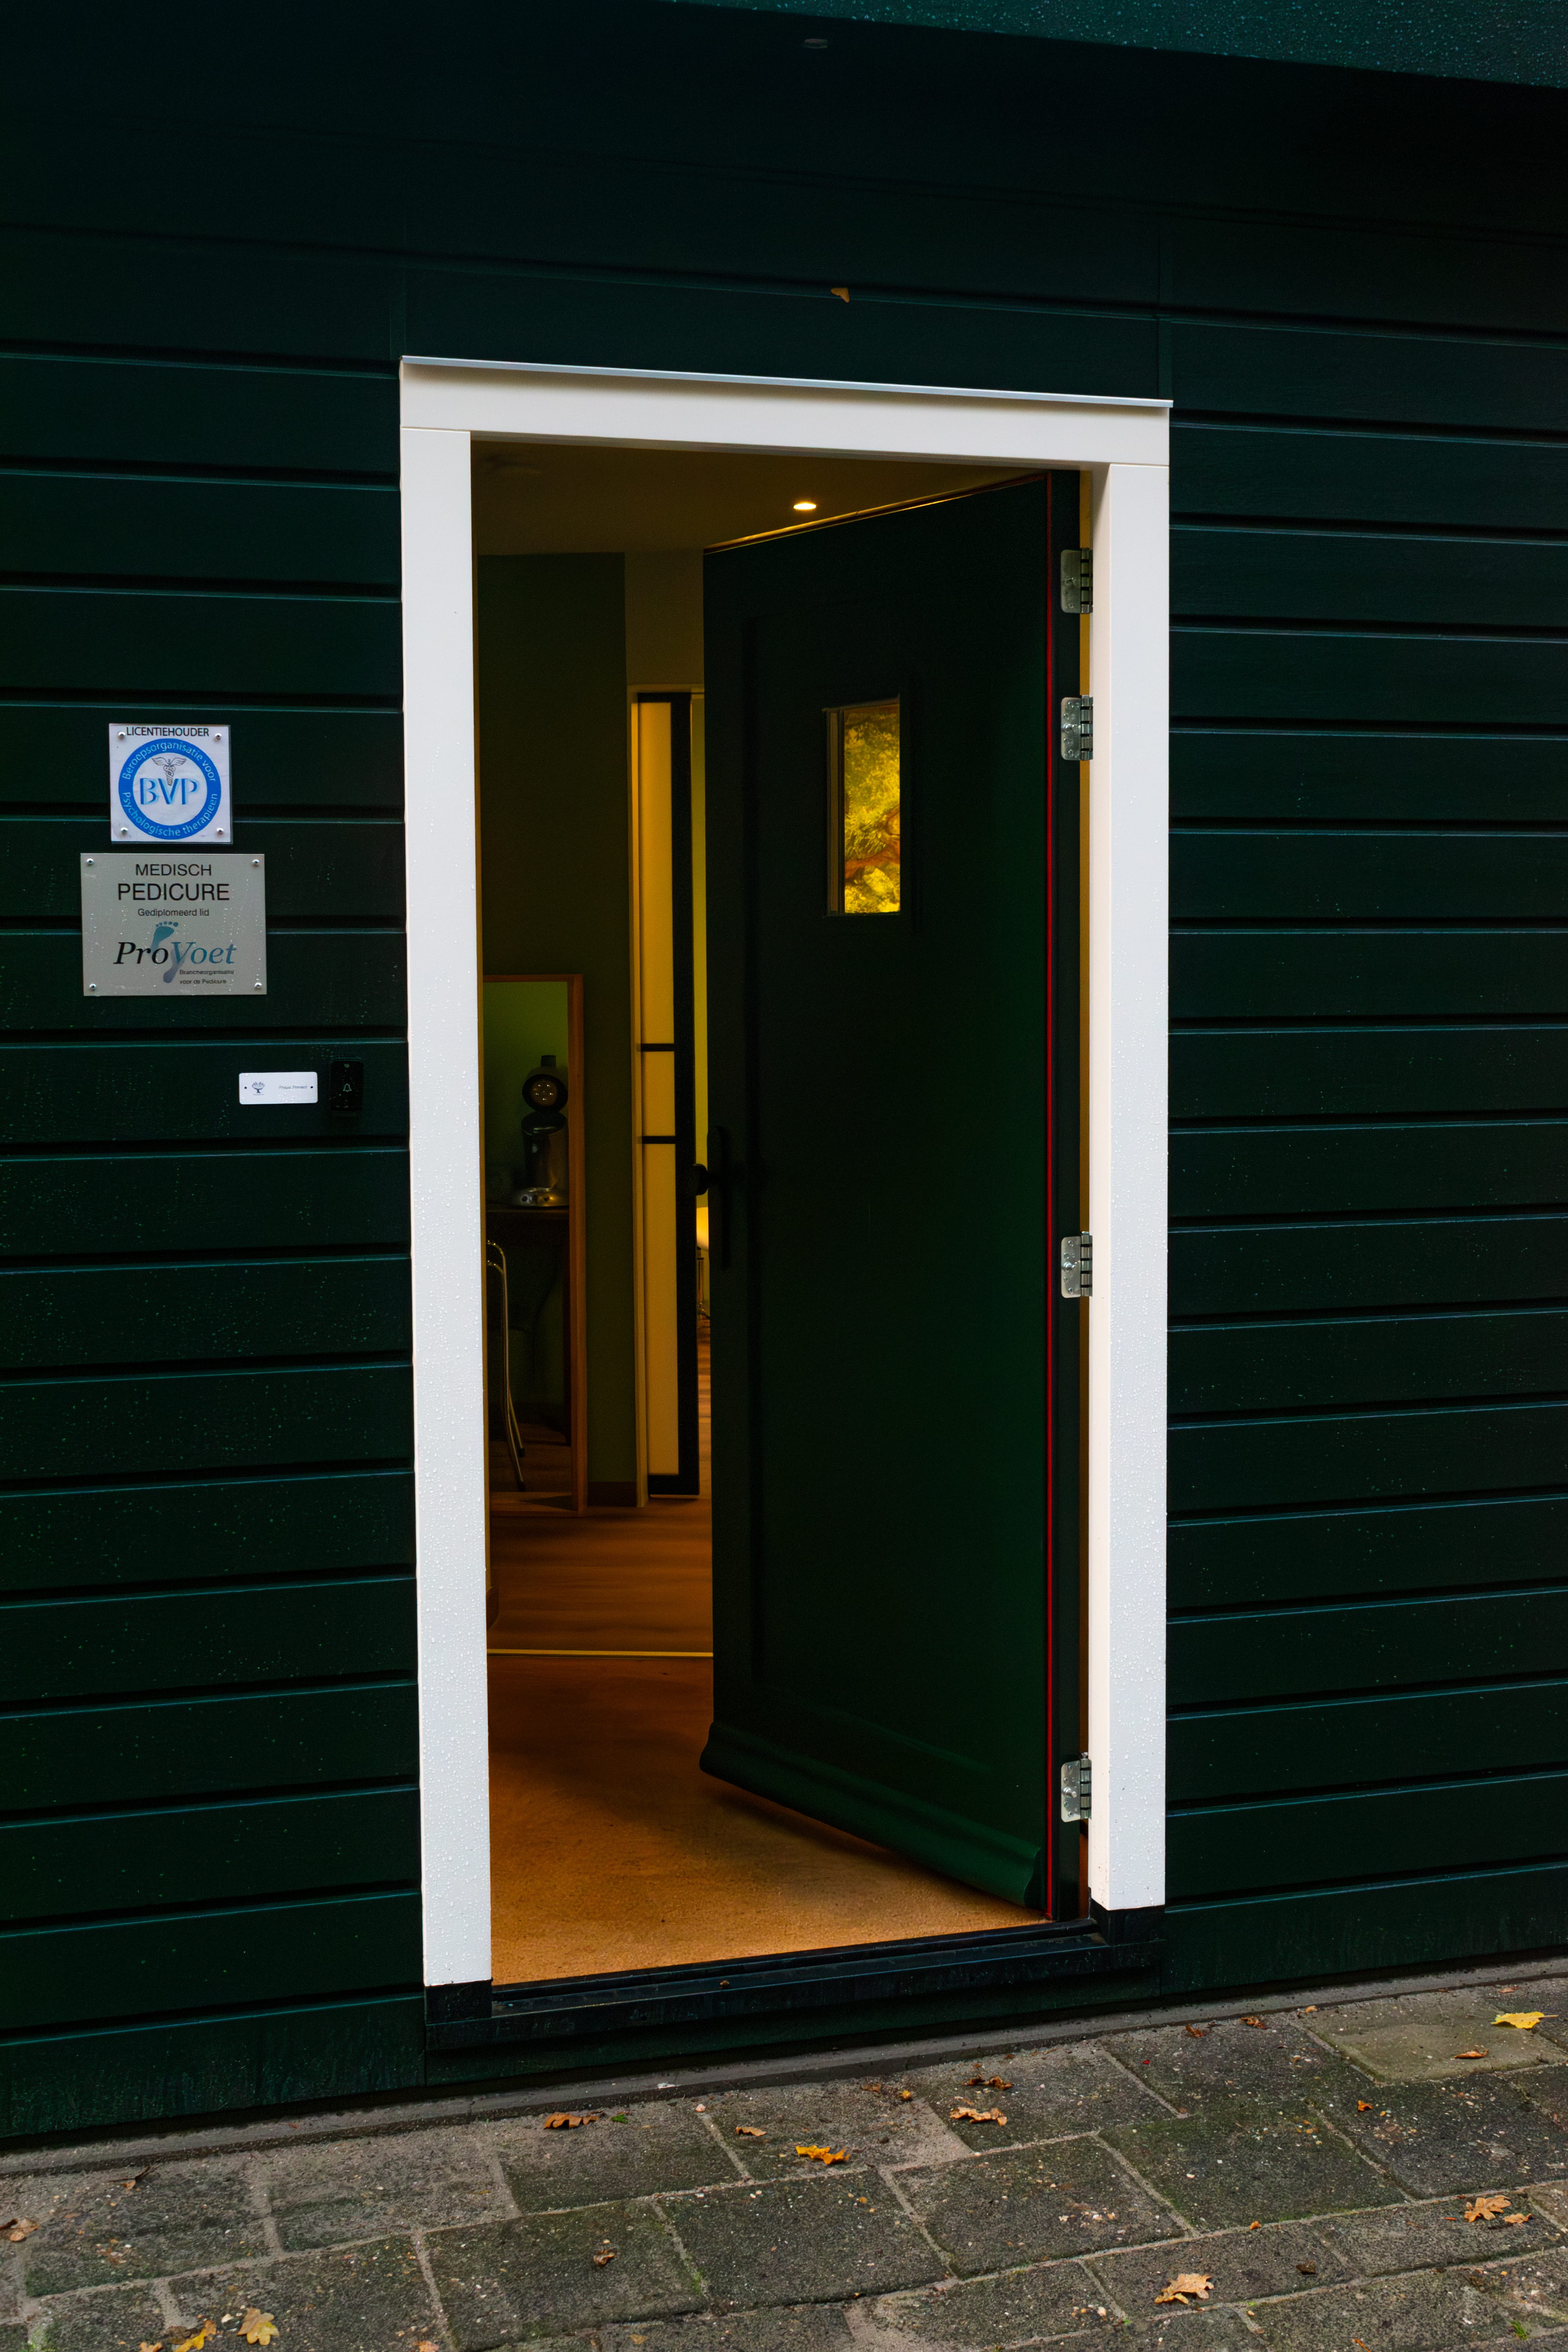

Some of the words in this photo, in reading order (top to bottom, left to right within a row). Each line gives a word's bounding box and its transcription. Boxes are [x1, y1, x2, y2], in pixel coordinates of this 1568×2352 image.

[126, 727, 209, 737] LICENTIEHOUDER
[122, 742, 203, 780] Beroepsorganisatie
[202, 760, 216, 782] voor
[140, 778, 199, 805] BVP
[122, 792, 180, 837] psychologische
[136, 864, 212, 876] MEDISCH
[118, 883, 230, 901] PEDICURE
[138, 908, 197, 917] Gediplomeerd
[200, 908, 209, 916] lid
[113, 942, 237, 965] ProVoet
